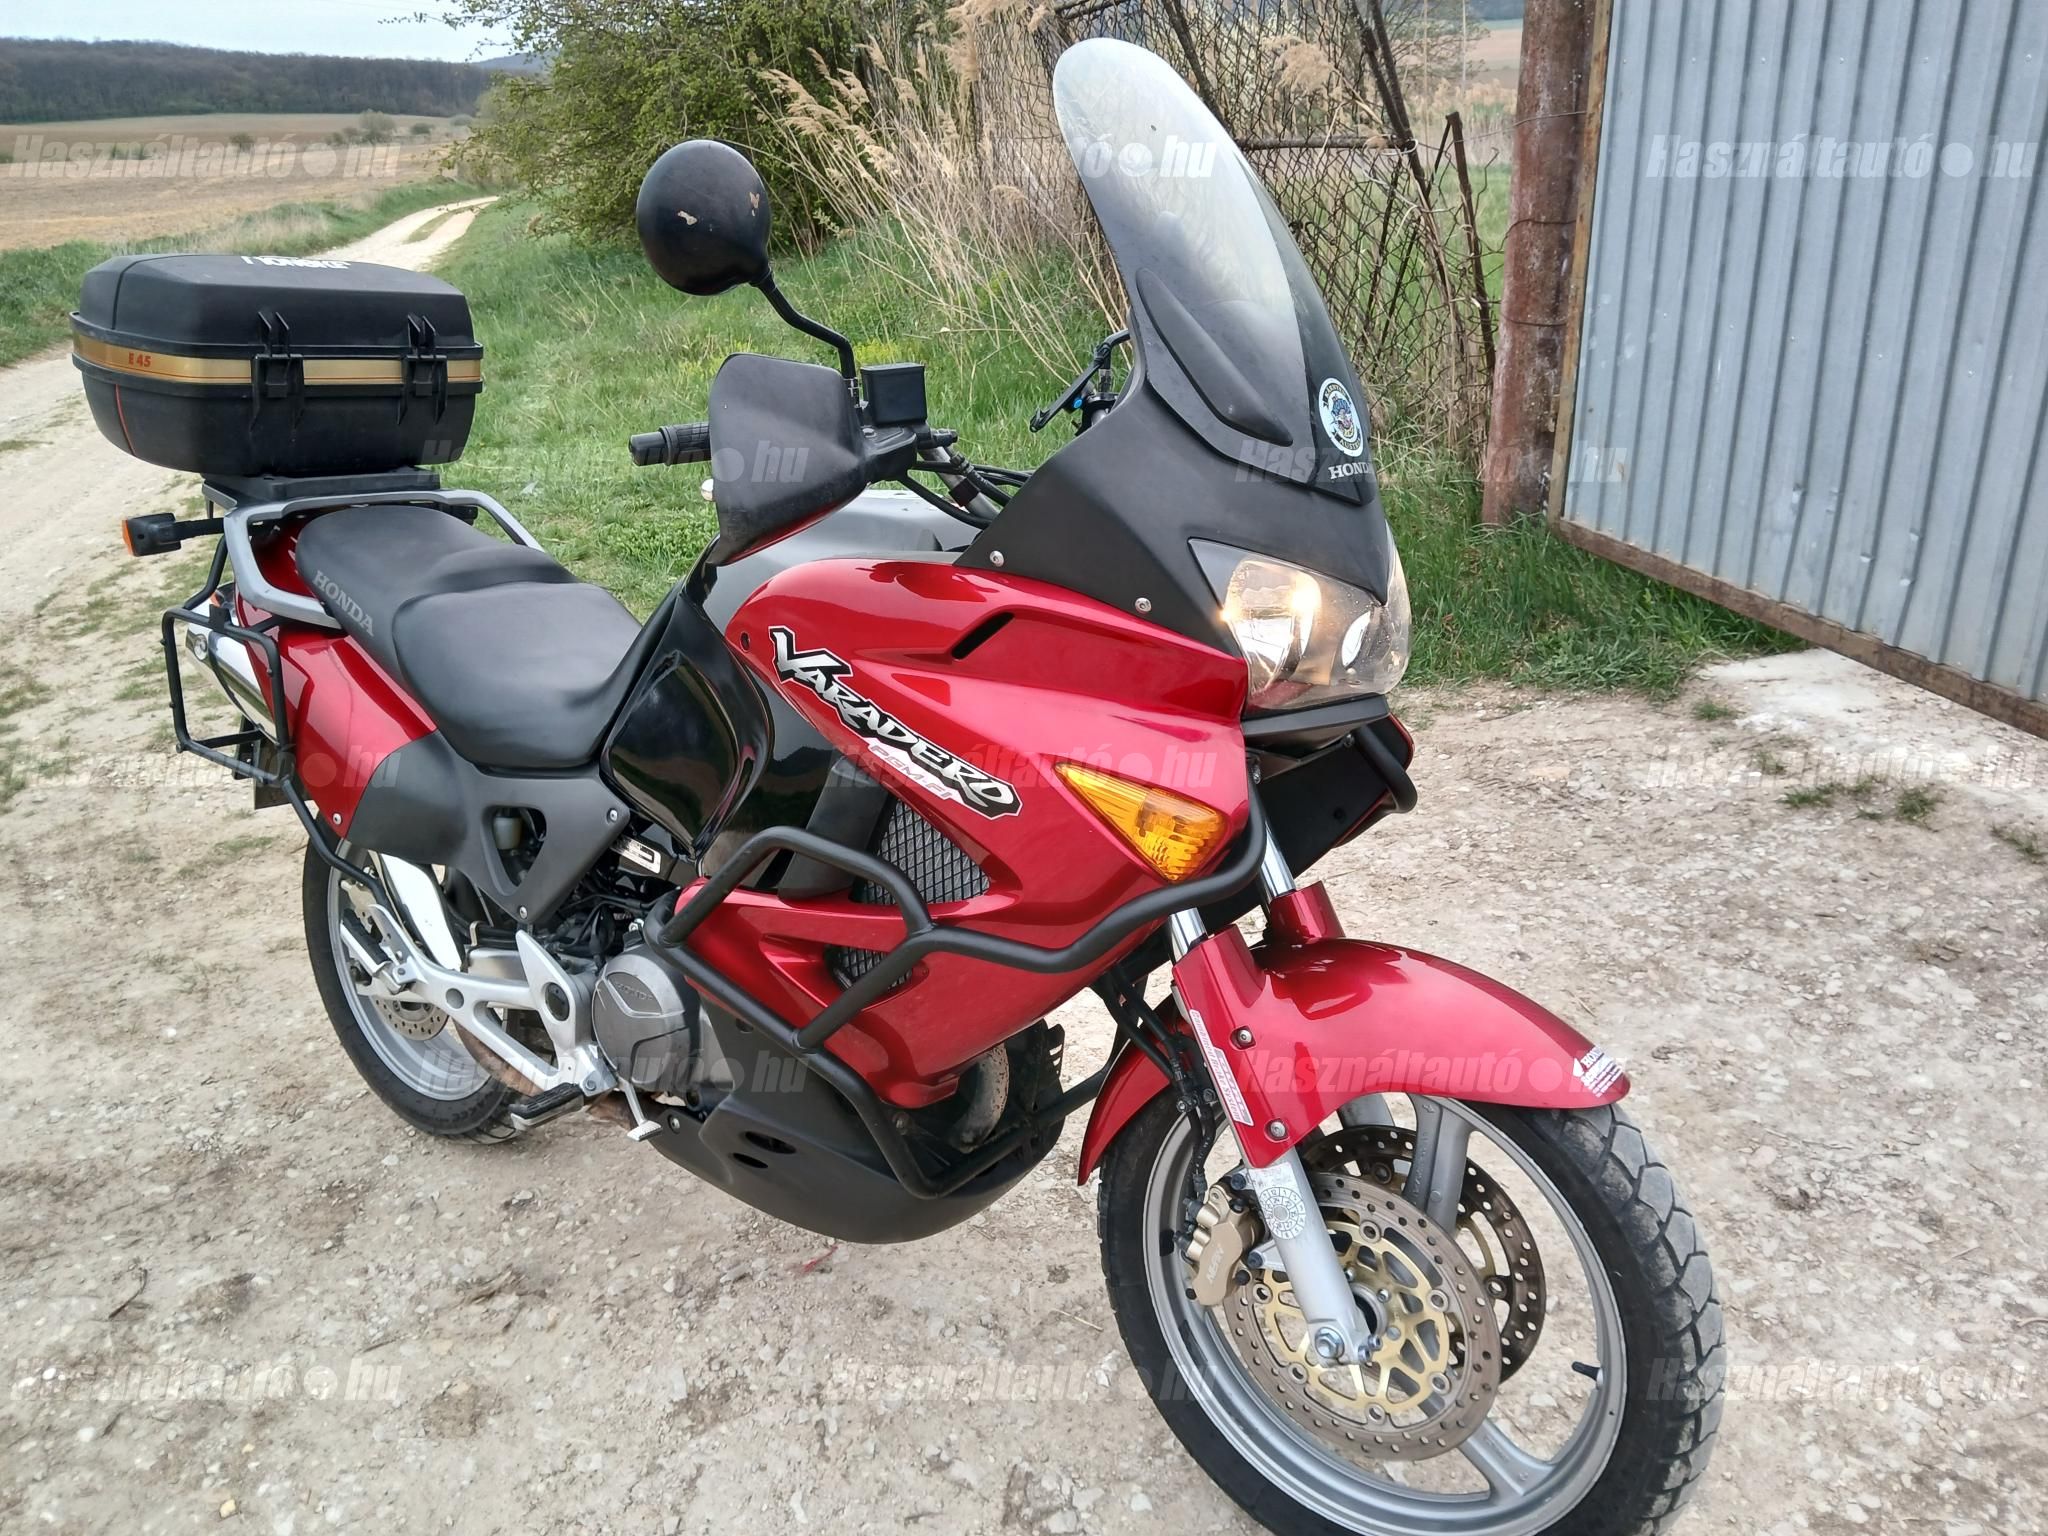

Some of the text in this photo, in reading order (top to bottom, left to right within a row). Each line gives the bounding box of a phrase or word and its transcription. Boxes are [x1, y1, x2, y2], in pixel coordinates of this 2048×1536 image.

[136, 352, 152, 368] 45
[1328, 462, 1373, 480] HOND
[312, 570, 374, 637] HONDA
[770, 629, 1017, 811] VARADERO
[870, 744, 952, 799] PGM-FI
